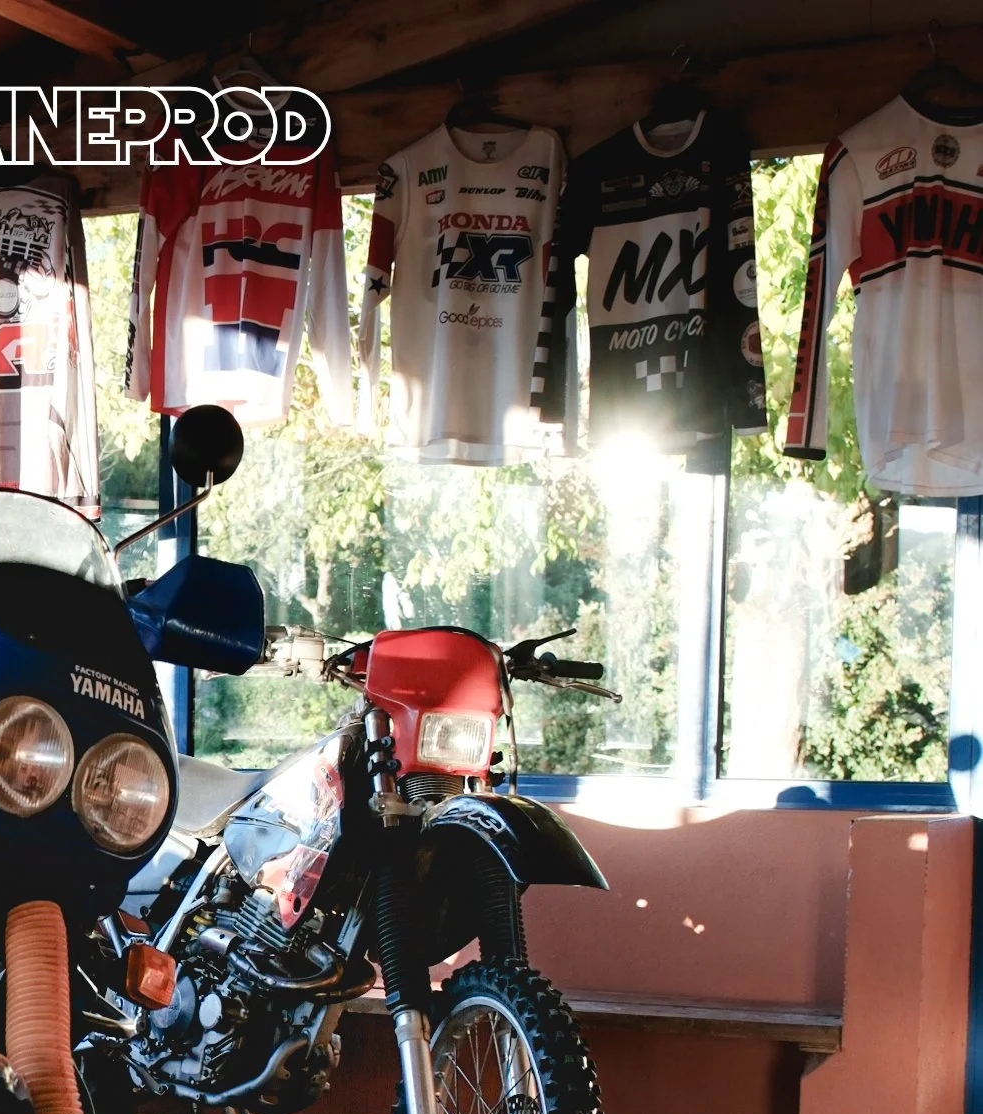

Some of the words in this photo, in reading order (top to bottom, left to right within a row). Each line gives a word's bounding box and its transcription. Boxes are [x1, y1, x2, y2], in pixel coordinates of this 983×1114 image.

[458, 187, 506, 195] DUNLOP
[438, 212, 532, 234] HONDA
[447, 232, 534, 283] XR
[609, 323, 658, 350] MOTO
[75, 664, 112, 682] FACTORY
[113, 678, 139, 696] RACING
[70, 673, 145, 720] YAMAHA
